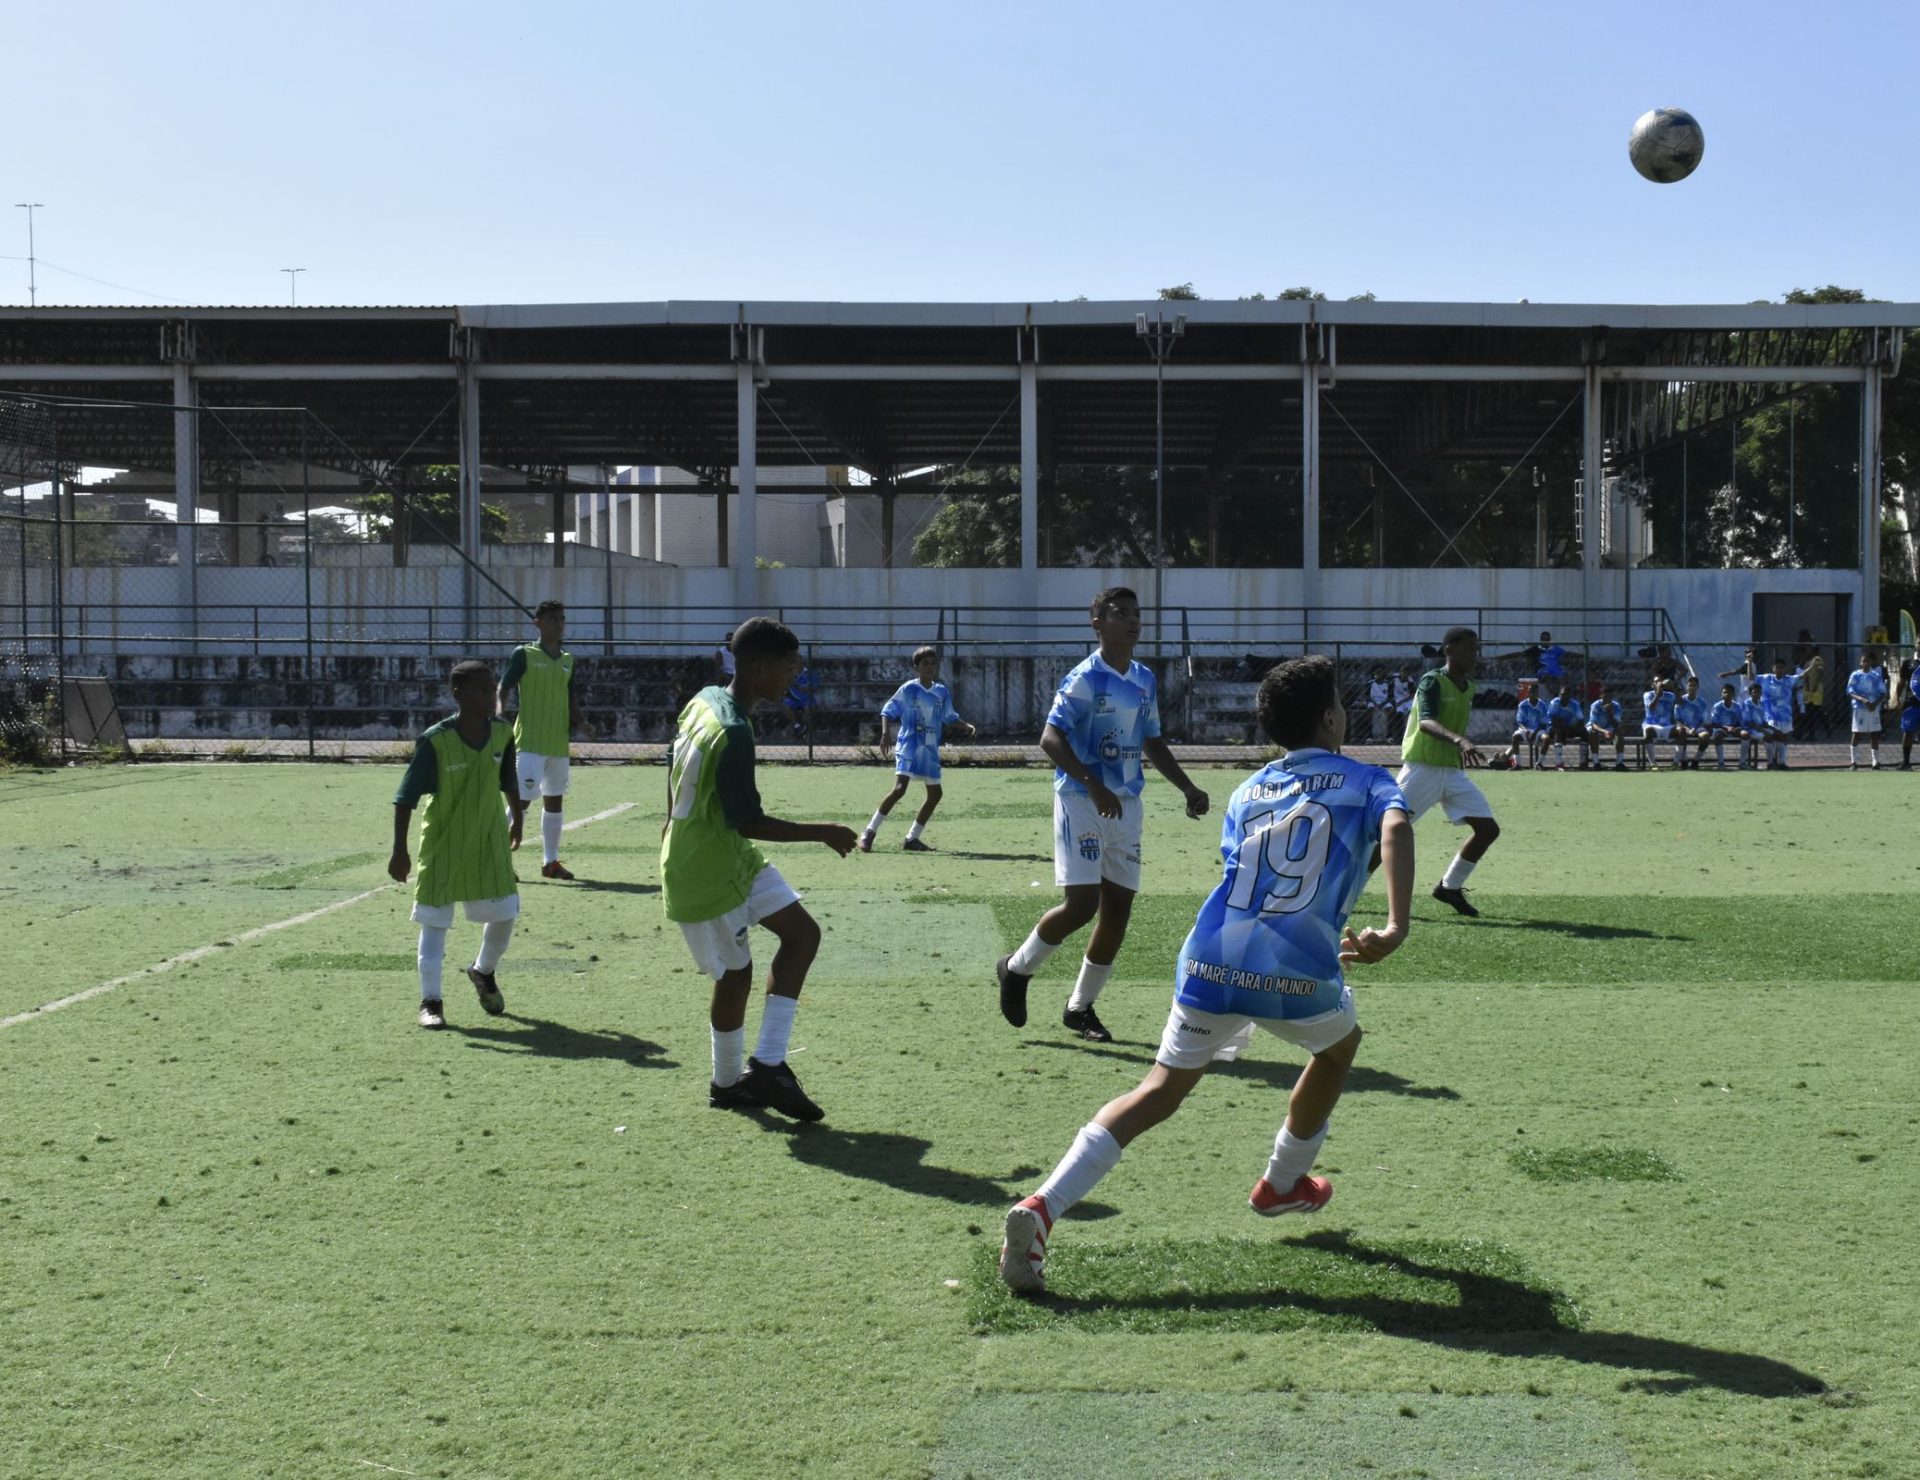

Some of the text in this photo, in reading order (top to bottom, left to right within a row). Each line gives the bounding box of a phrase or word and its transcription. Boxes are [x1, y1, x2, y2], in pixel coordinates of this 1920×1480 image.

[1290, 772, 1346, 796] MIRIM
[1226, 800, 1333, 914] 19
[1186, 958, 1317, 996] DA MARÉ PARA O MUNDO
